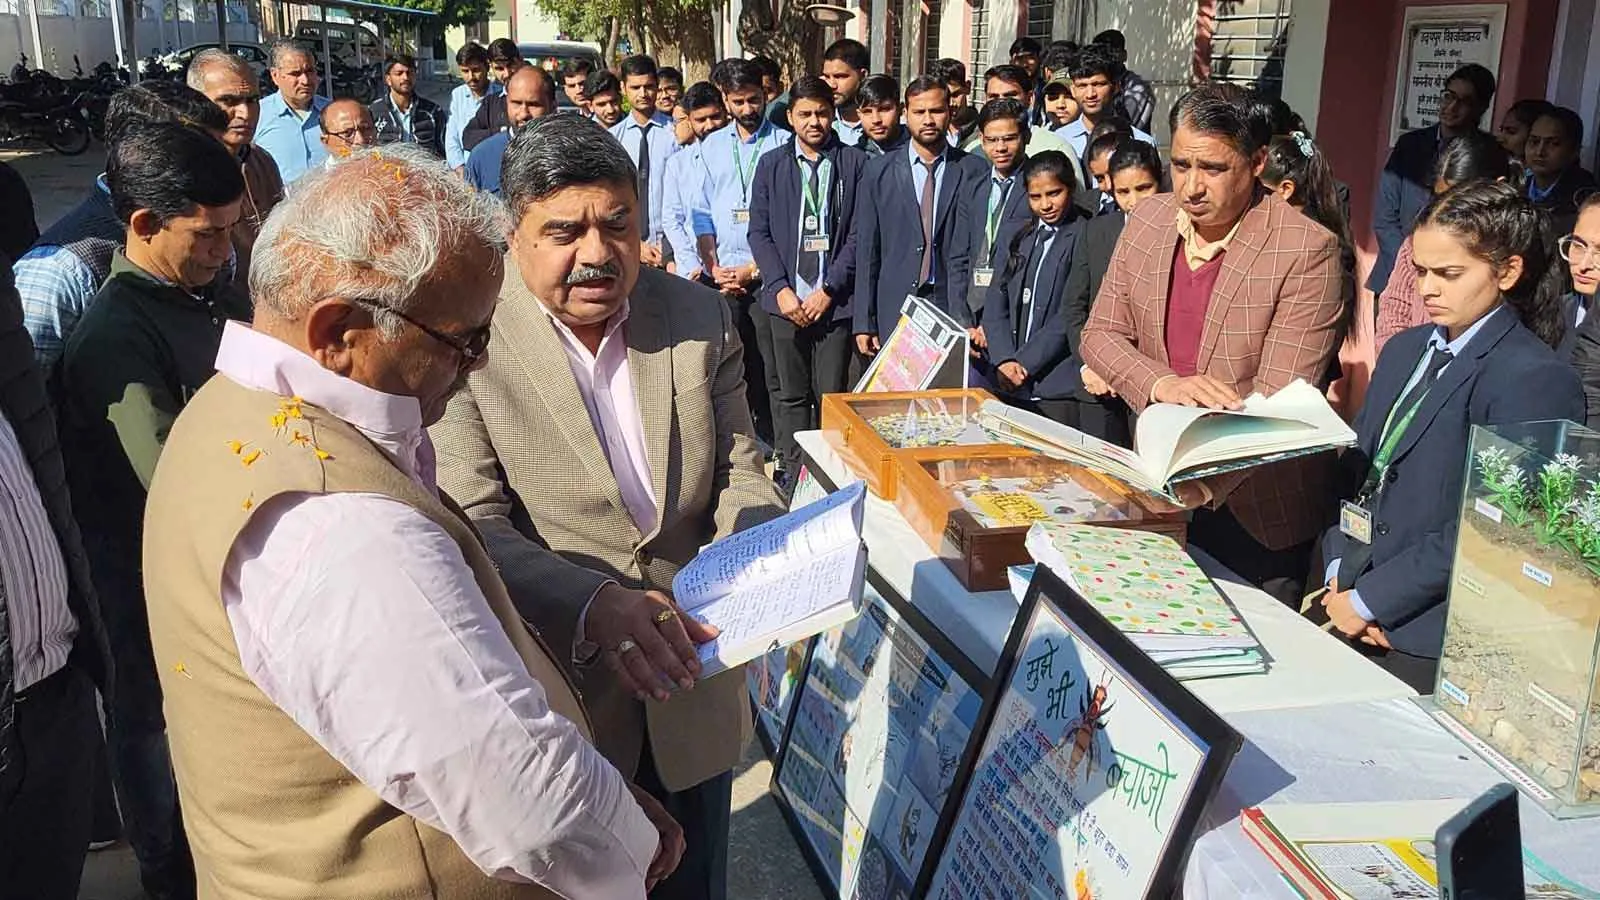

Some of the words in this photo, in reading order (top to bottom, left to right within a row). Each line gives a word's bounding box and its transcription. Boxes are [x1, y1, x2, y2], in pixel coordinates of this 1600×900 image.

[1026, 638, 1060, 692] मुझे
[1046, 670, 1076, 720] भी
[1106, 742, 1178, 834] बचाओ
